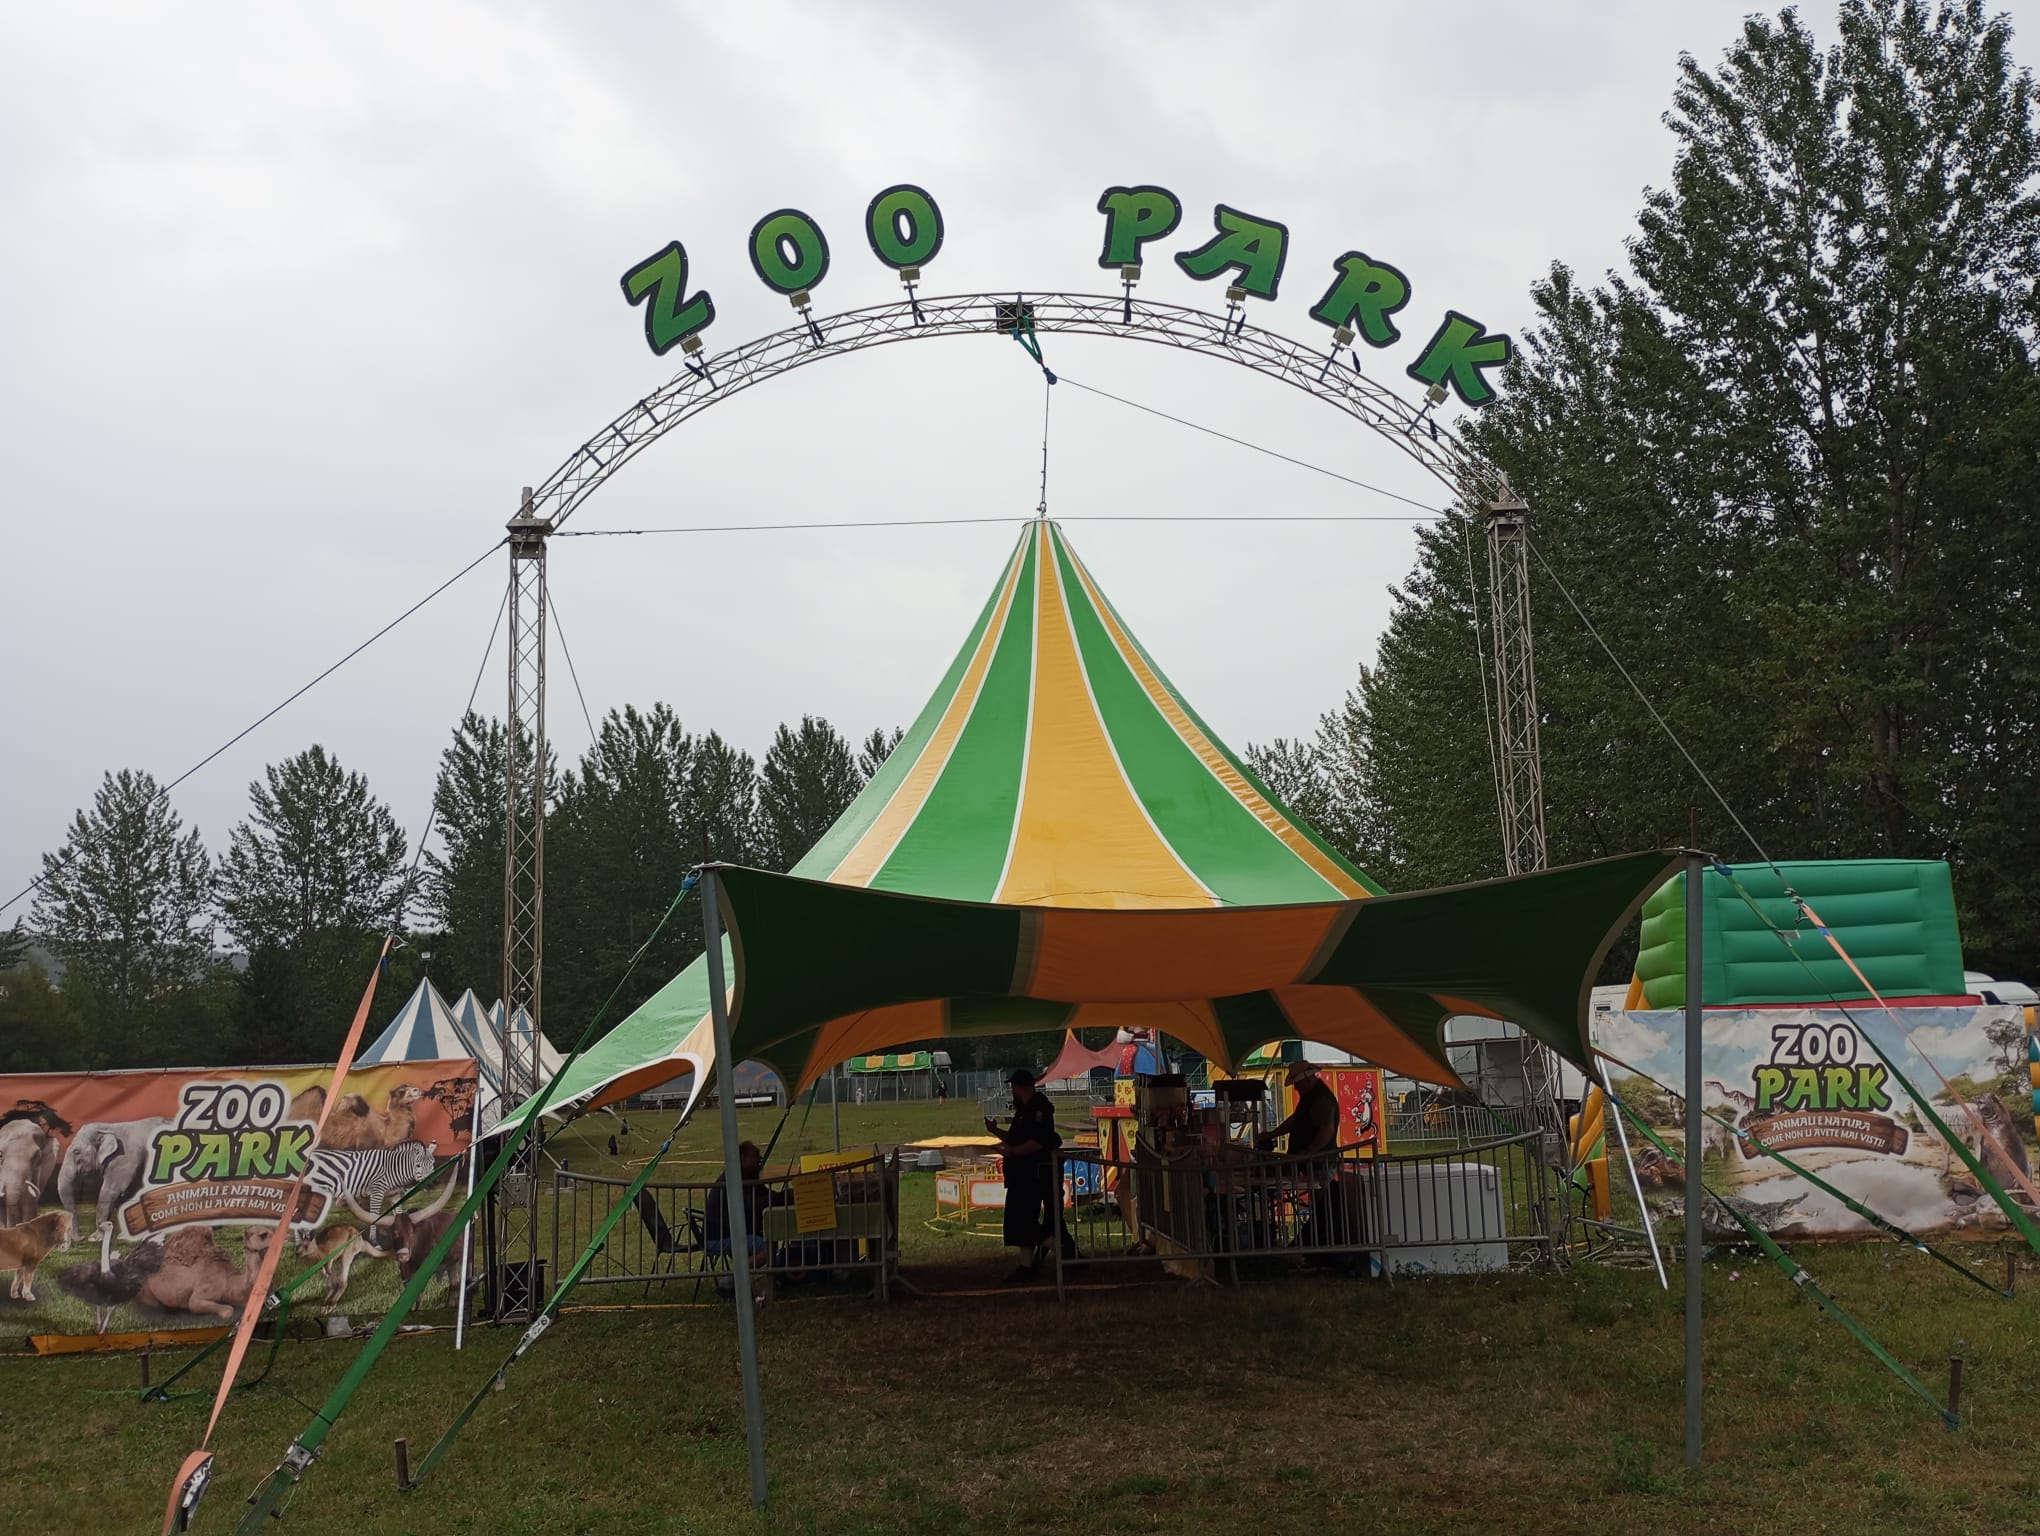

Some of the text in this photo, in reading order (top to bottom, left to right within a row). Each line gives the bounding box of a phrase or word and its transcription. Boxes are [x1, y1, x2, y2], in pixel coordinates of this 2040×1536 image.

[619, 183, 1513, 408] ZOO PARK
[1772, 1025, 1856, 1065] ZOO
[179, 1085, 283, 1131] ZOO
[1753, 1065, 1891, 1111] PARK
[1761, 1128, 1886, 1148] COME NON LI AVETE MAI VISTI!
[1772, 1116, 1871, 1131] ANIMALI E NATURA
[150, 1126, 313, 1182] PARK
[151, 1198, 298, 1222] COME NON LI AVETE MAI VIS!
[167, 1185, 284, 1204] ANIMALI E NATURA
